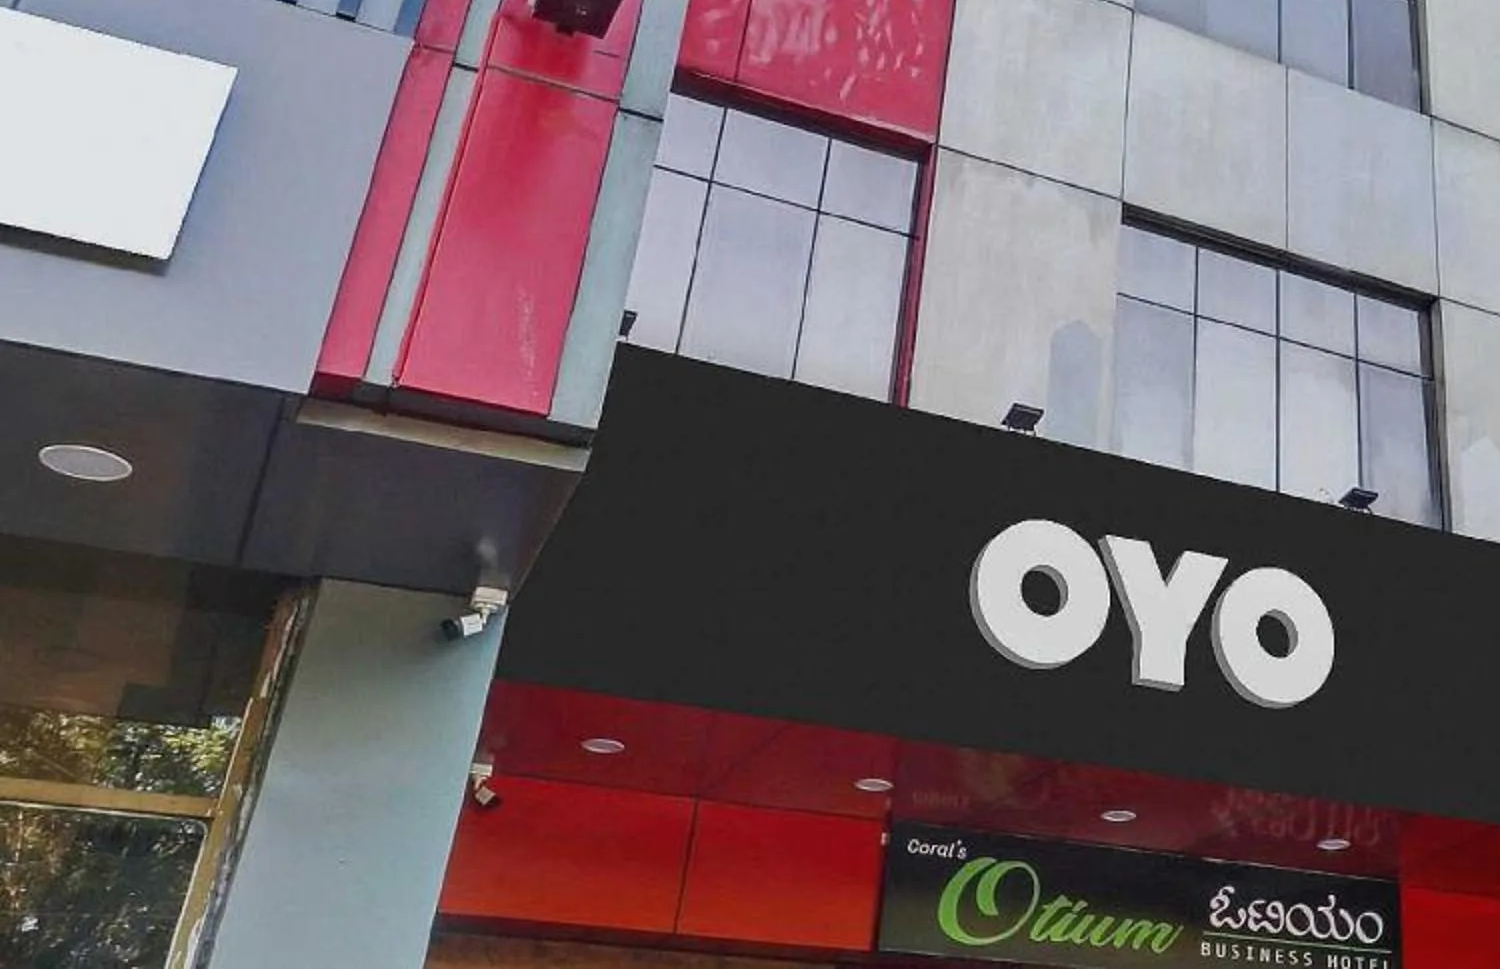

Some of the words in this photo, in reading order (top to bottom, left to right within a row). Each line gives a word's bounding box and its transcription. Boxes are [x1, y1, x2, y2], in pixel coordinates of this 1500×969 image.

[970, 519, 1335, 709] OYO
[906, 838, 968, 861] Coral's
[937, 856, 1184, 954] Otium
[1200, 942, 1314, 968] BUSINESS
